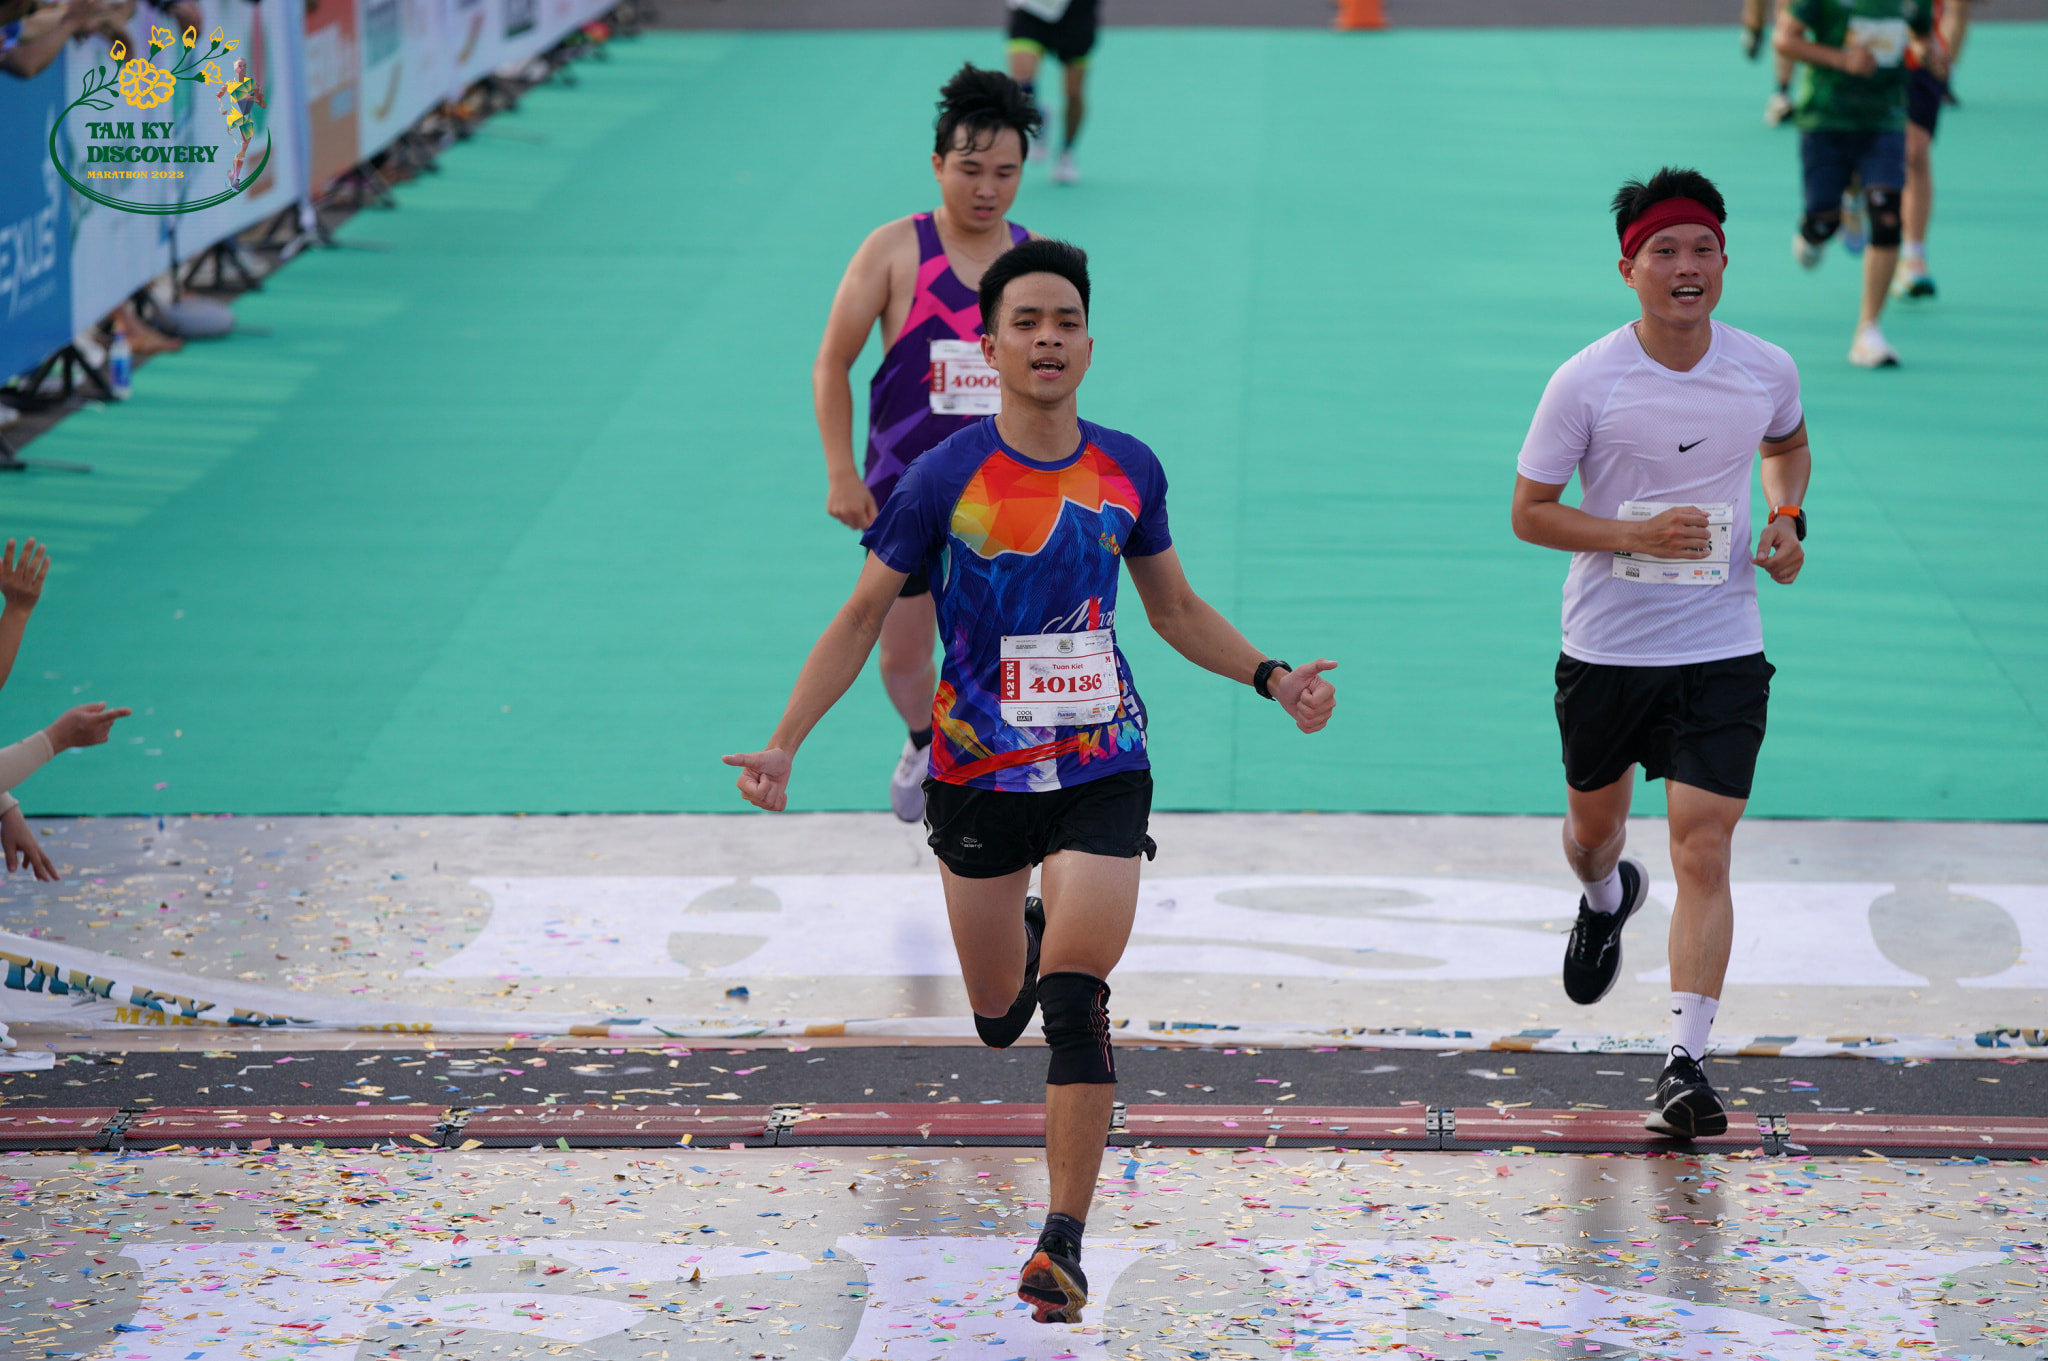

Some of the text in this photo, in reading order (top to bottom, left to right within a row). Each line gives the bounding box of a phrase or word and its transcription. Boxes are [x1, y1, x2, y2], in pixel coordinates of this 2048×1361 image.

[1105, 655, 1111, 663] M
[1006, 662, 1015, 698] 42 KM
[1029, 673, 1103, 693] 40136
